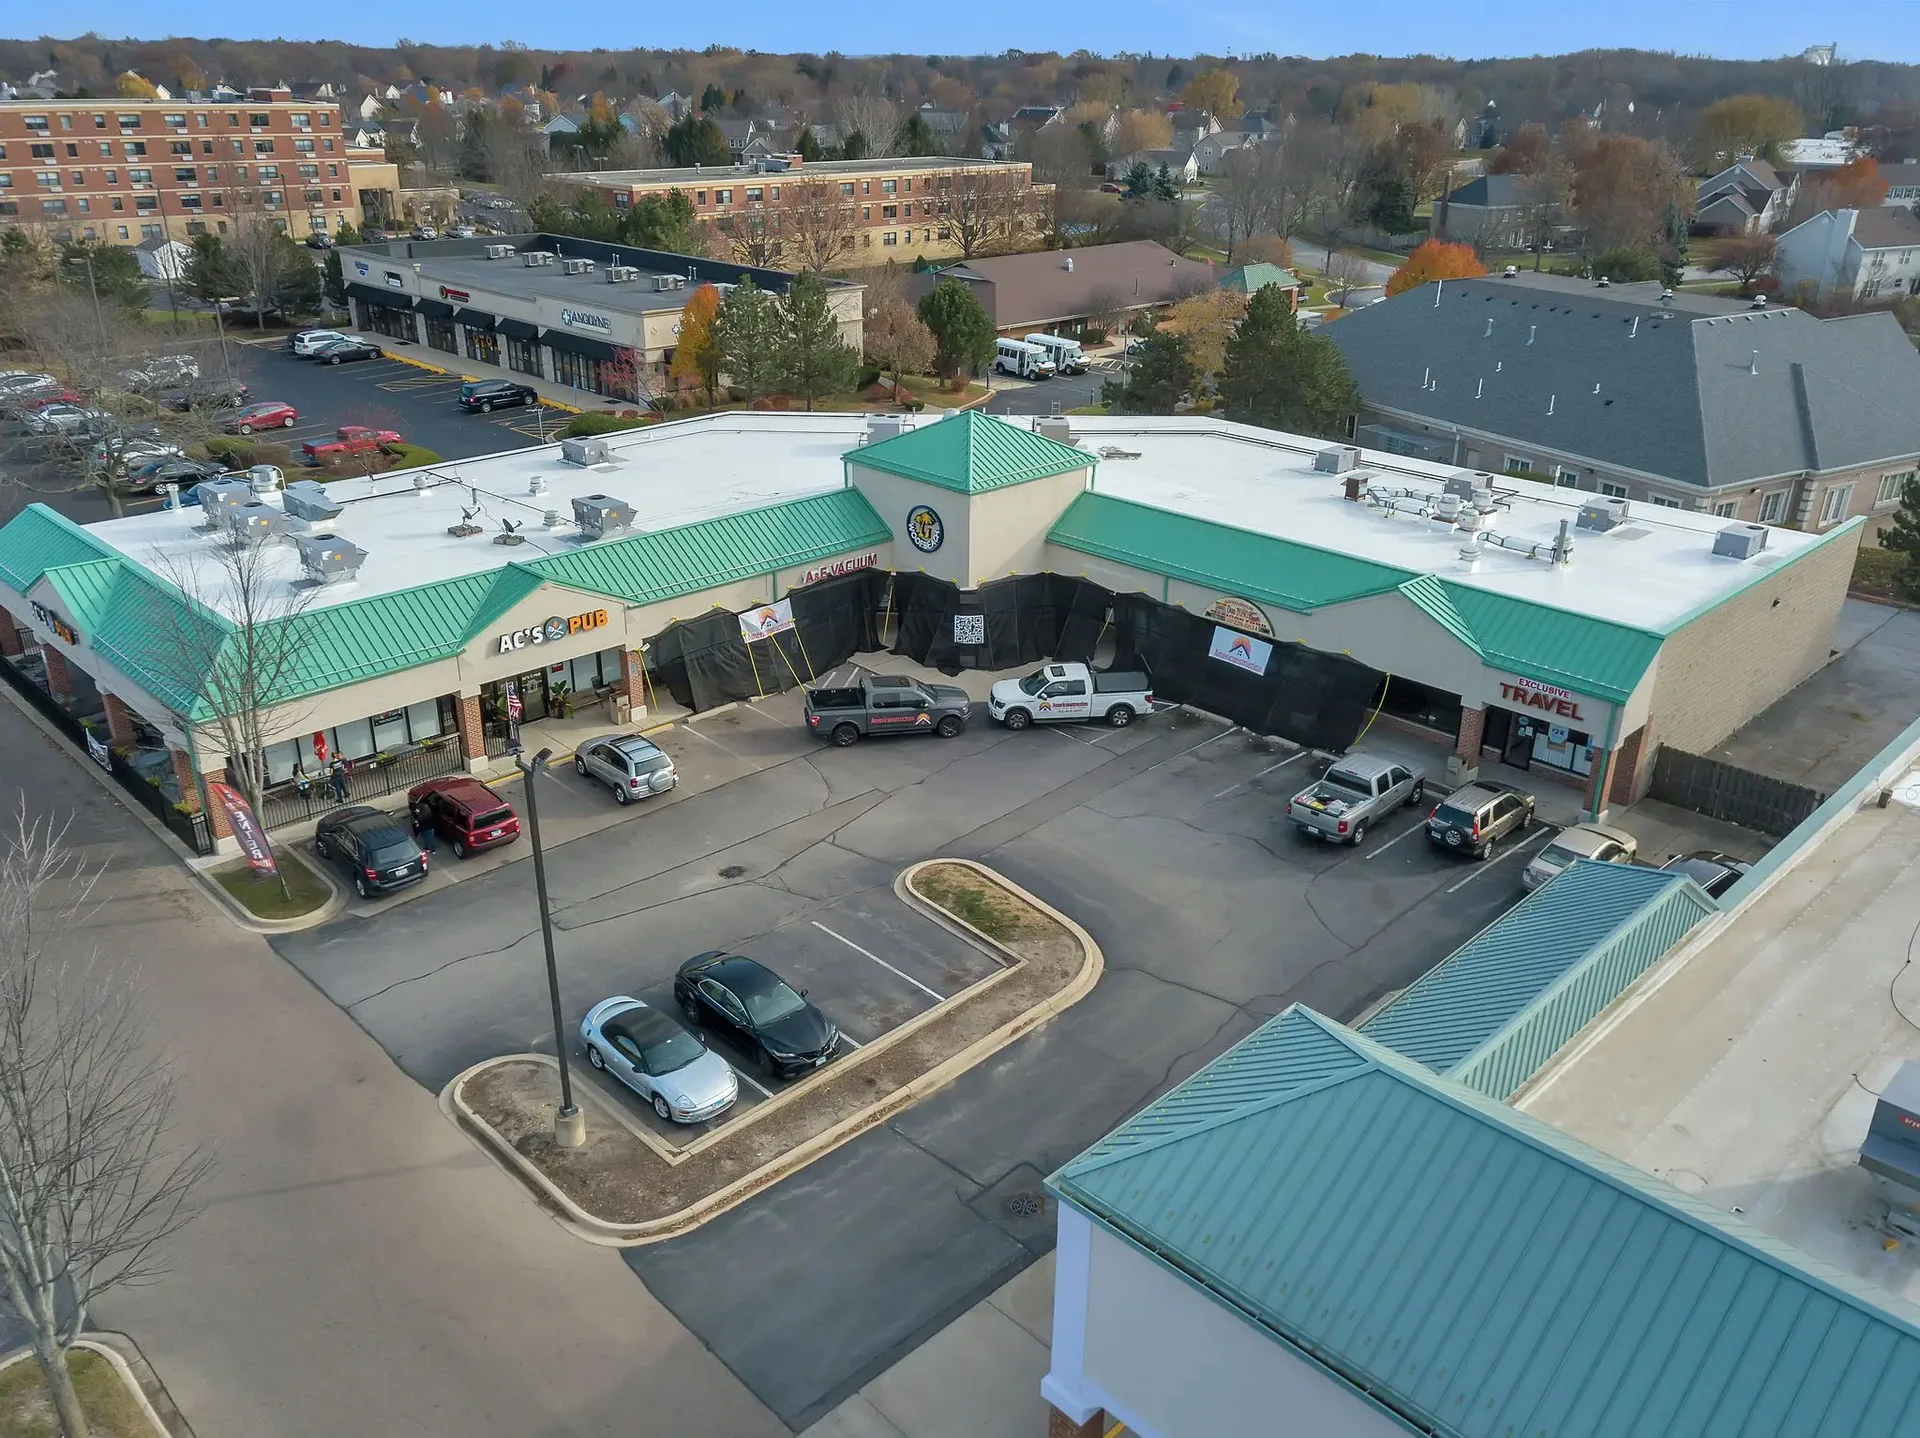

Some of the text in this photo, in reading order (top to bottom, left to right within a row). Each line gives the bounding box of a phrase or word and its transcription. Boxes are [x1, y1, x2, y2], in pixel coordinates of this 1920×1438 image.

[803, 553, 878, 584] A&E VACUUM
[499, 608, 608, 653] AC'S PUB
[1499, 682, 1584, 721] TRAVEL
[1518, 678, 1571, 699] EXCLUSIVE
